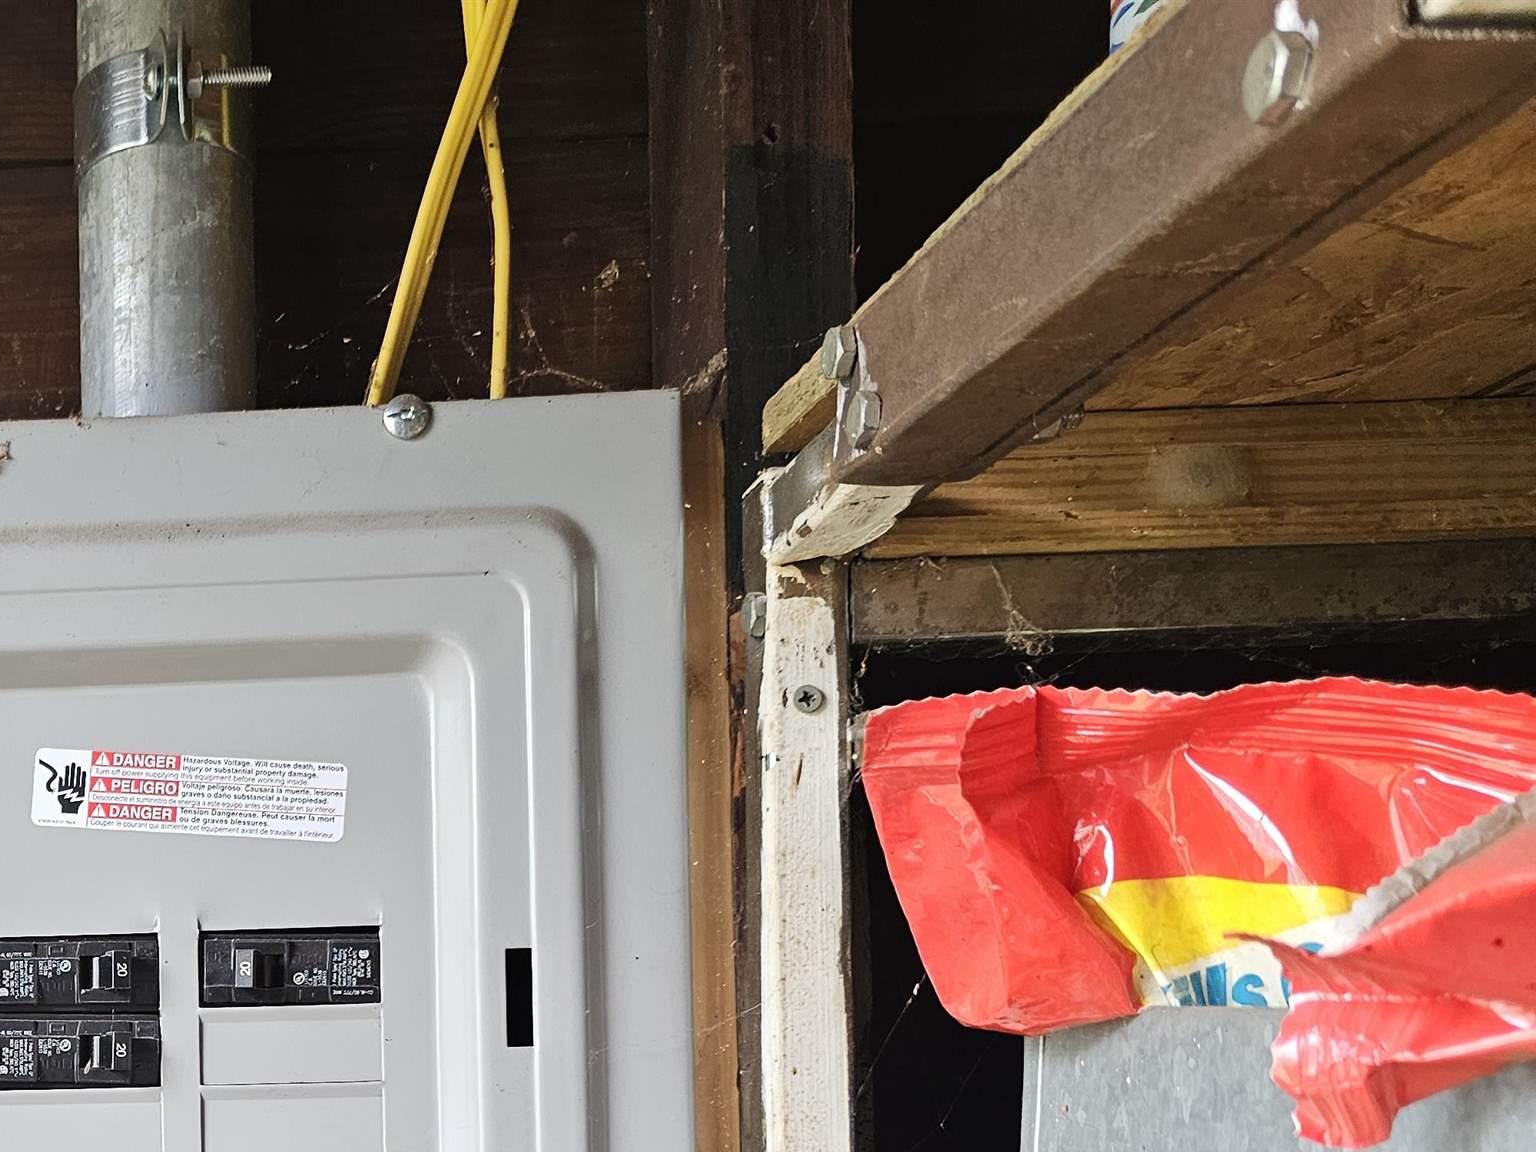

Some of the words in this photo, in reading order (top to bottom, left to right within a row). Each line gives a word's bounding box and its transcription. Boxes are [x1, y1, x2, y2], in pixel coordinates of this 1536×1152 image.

[113, 753, 176, 768] DANGER
[183, 756, 221, 764] Hazardous
[223, 759, 251, 767] Voltage.
[292, 762, 315, 771] death,
[317, 763, 345, 772] serious
[255, 769, 286, 777] property
[287, 770, 318, 779] damage.
[111, 779, 176, 794] PELIGRO
[181, 782, 205, 790] Voltaje
[312, 788, 343, 797] lesiones
[233, 793, 274, 801] substancial
[109, 804, 172, 820] DANGER
[259, 811, 279, 819] Peut
[279, 812, 307, 820] causer
[307, 813, 316, 821] la
[316, 814, 336, 822] mort
[116, 962, 128, 977] 20
[239, 961, 251, 976] 20
[115, 1042, 127, 1058] 20
